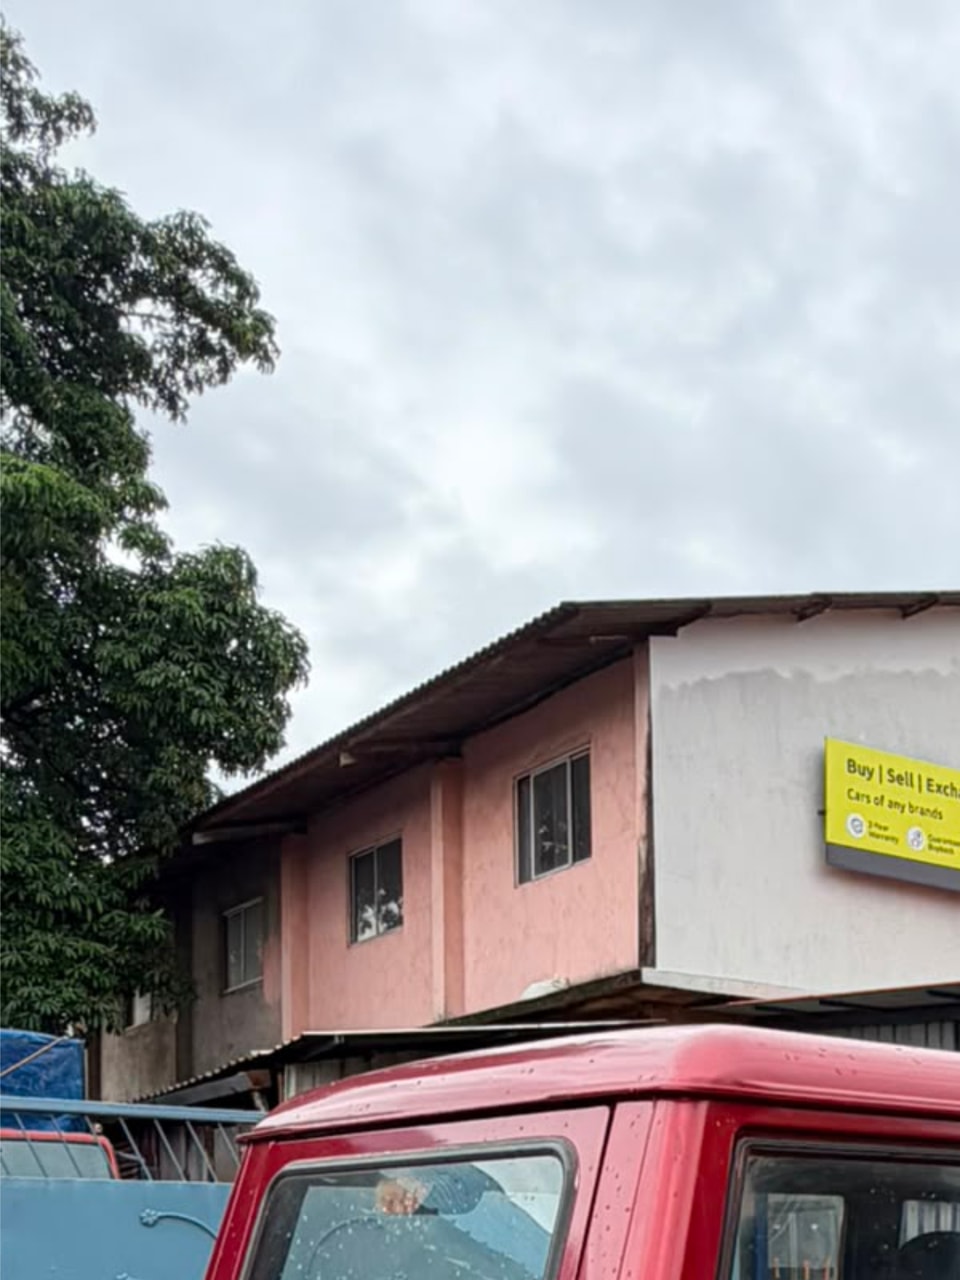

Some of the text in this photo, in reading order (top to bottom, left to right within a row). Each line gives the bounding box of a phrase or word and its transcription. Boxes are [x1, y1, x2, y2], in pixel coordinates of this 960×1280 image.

[846, 758, 874, 781] Buy
[886, 768, 914, 788] Sell
[847, 788, 943, 820] Cars of any brands
